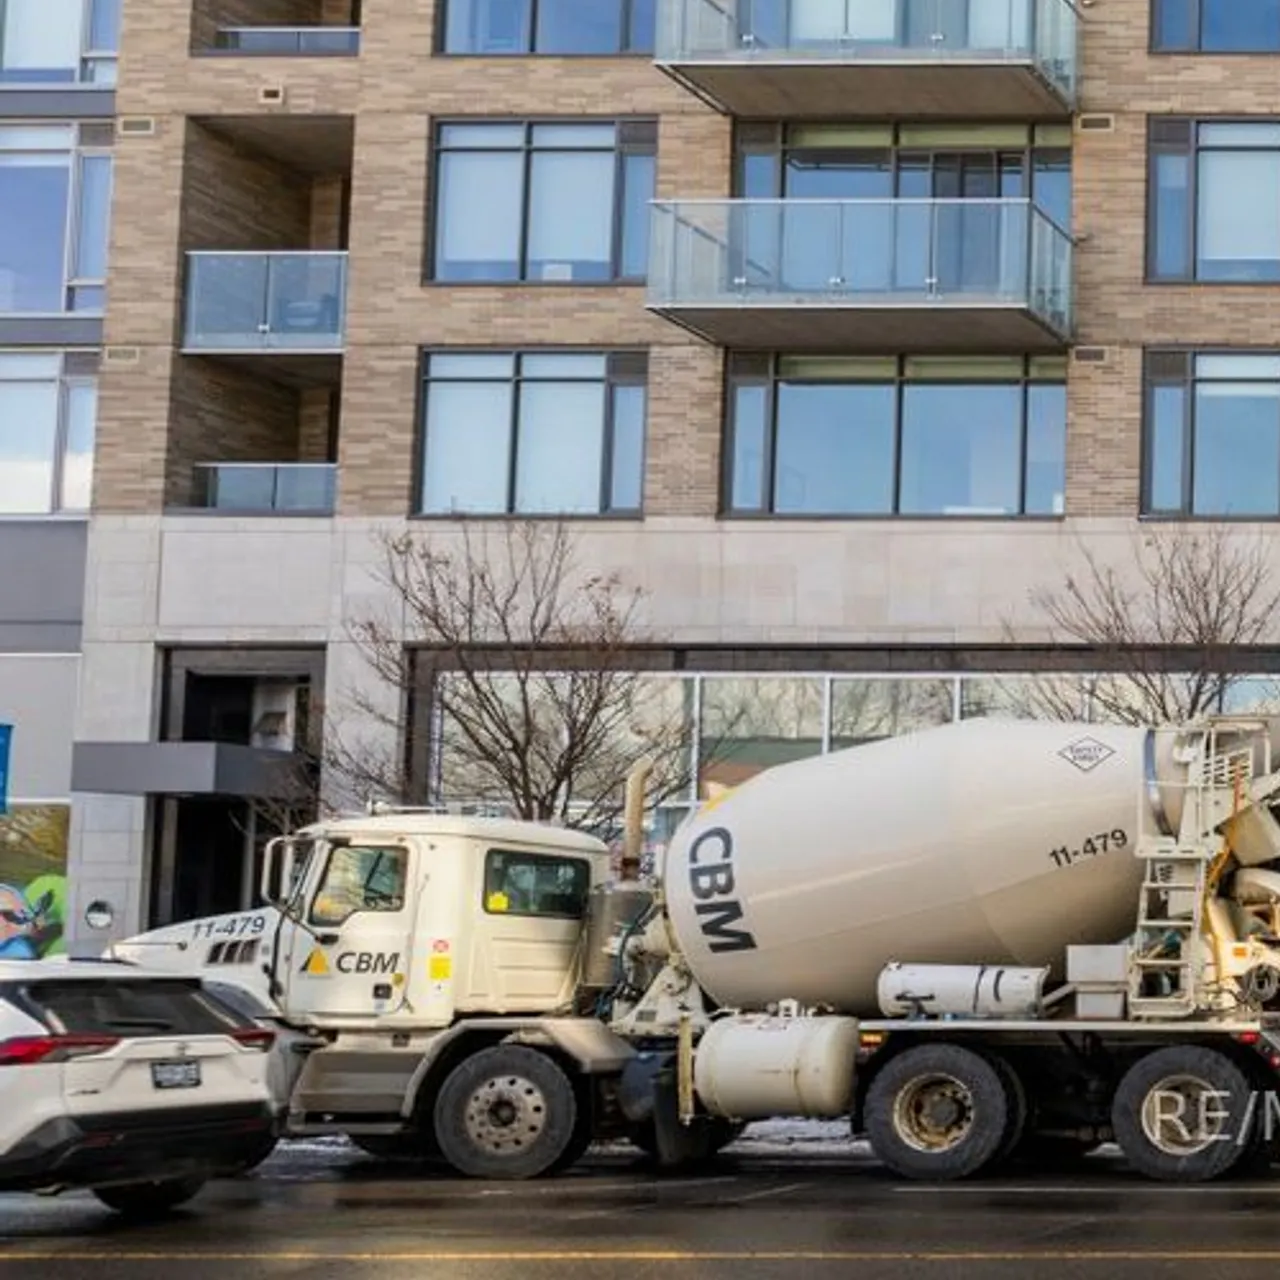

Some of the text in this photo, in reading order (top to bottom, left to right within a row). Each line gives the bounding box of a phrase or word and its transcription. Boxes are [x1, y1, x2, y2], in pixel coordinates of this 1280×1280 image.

[1049, 828, 1127, 867] 11-479
[689, 827, 757, 953] CBM
[192, 916, 265, 938] 11-479
[336, 952, 400, 974] CBM
